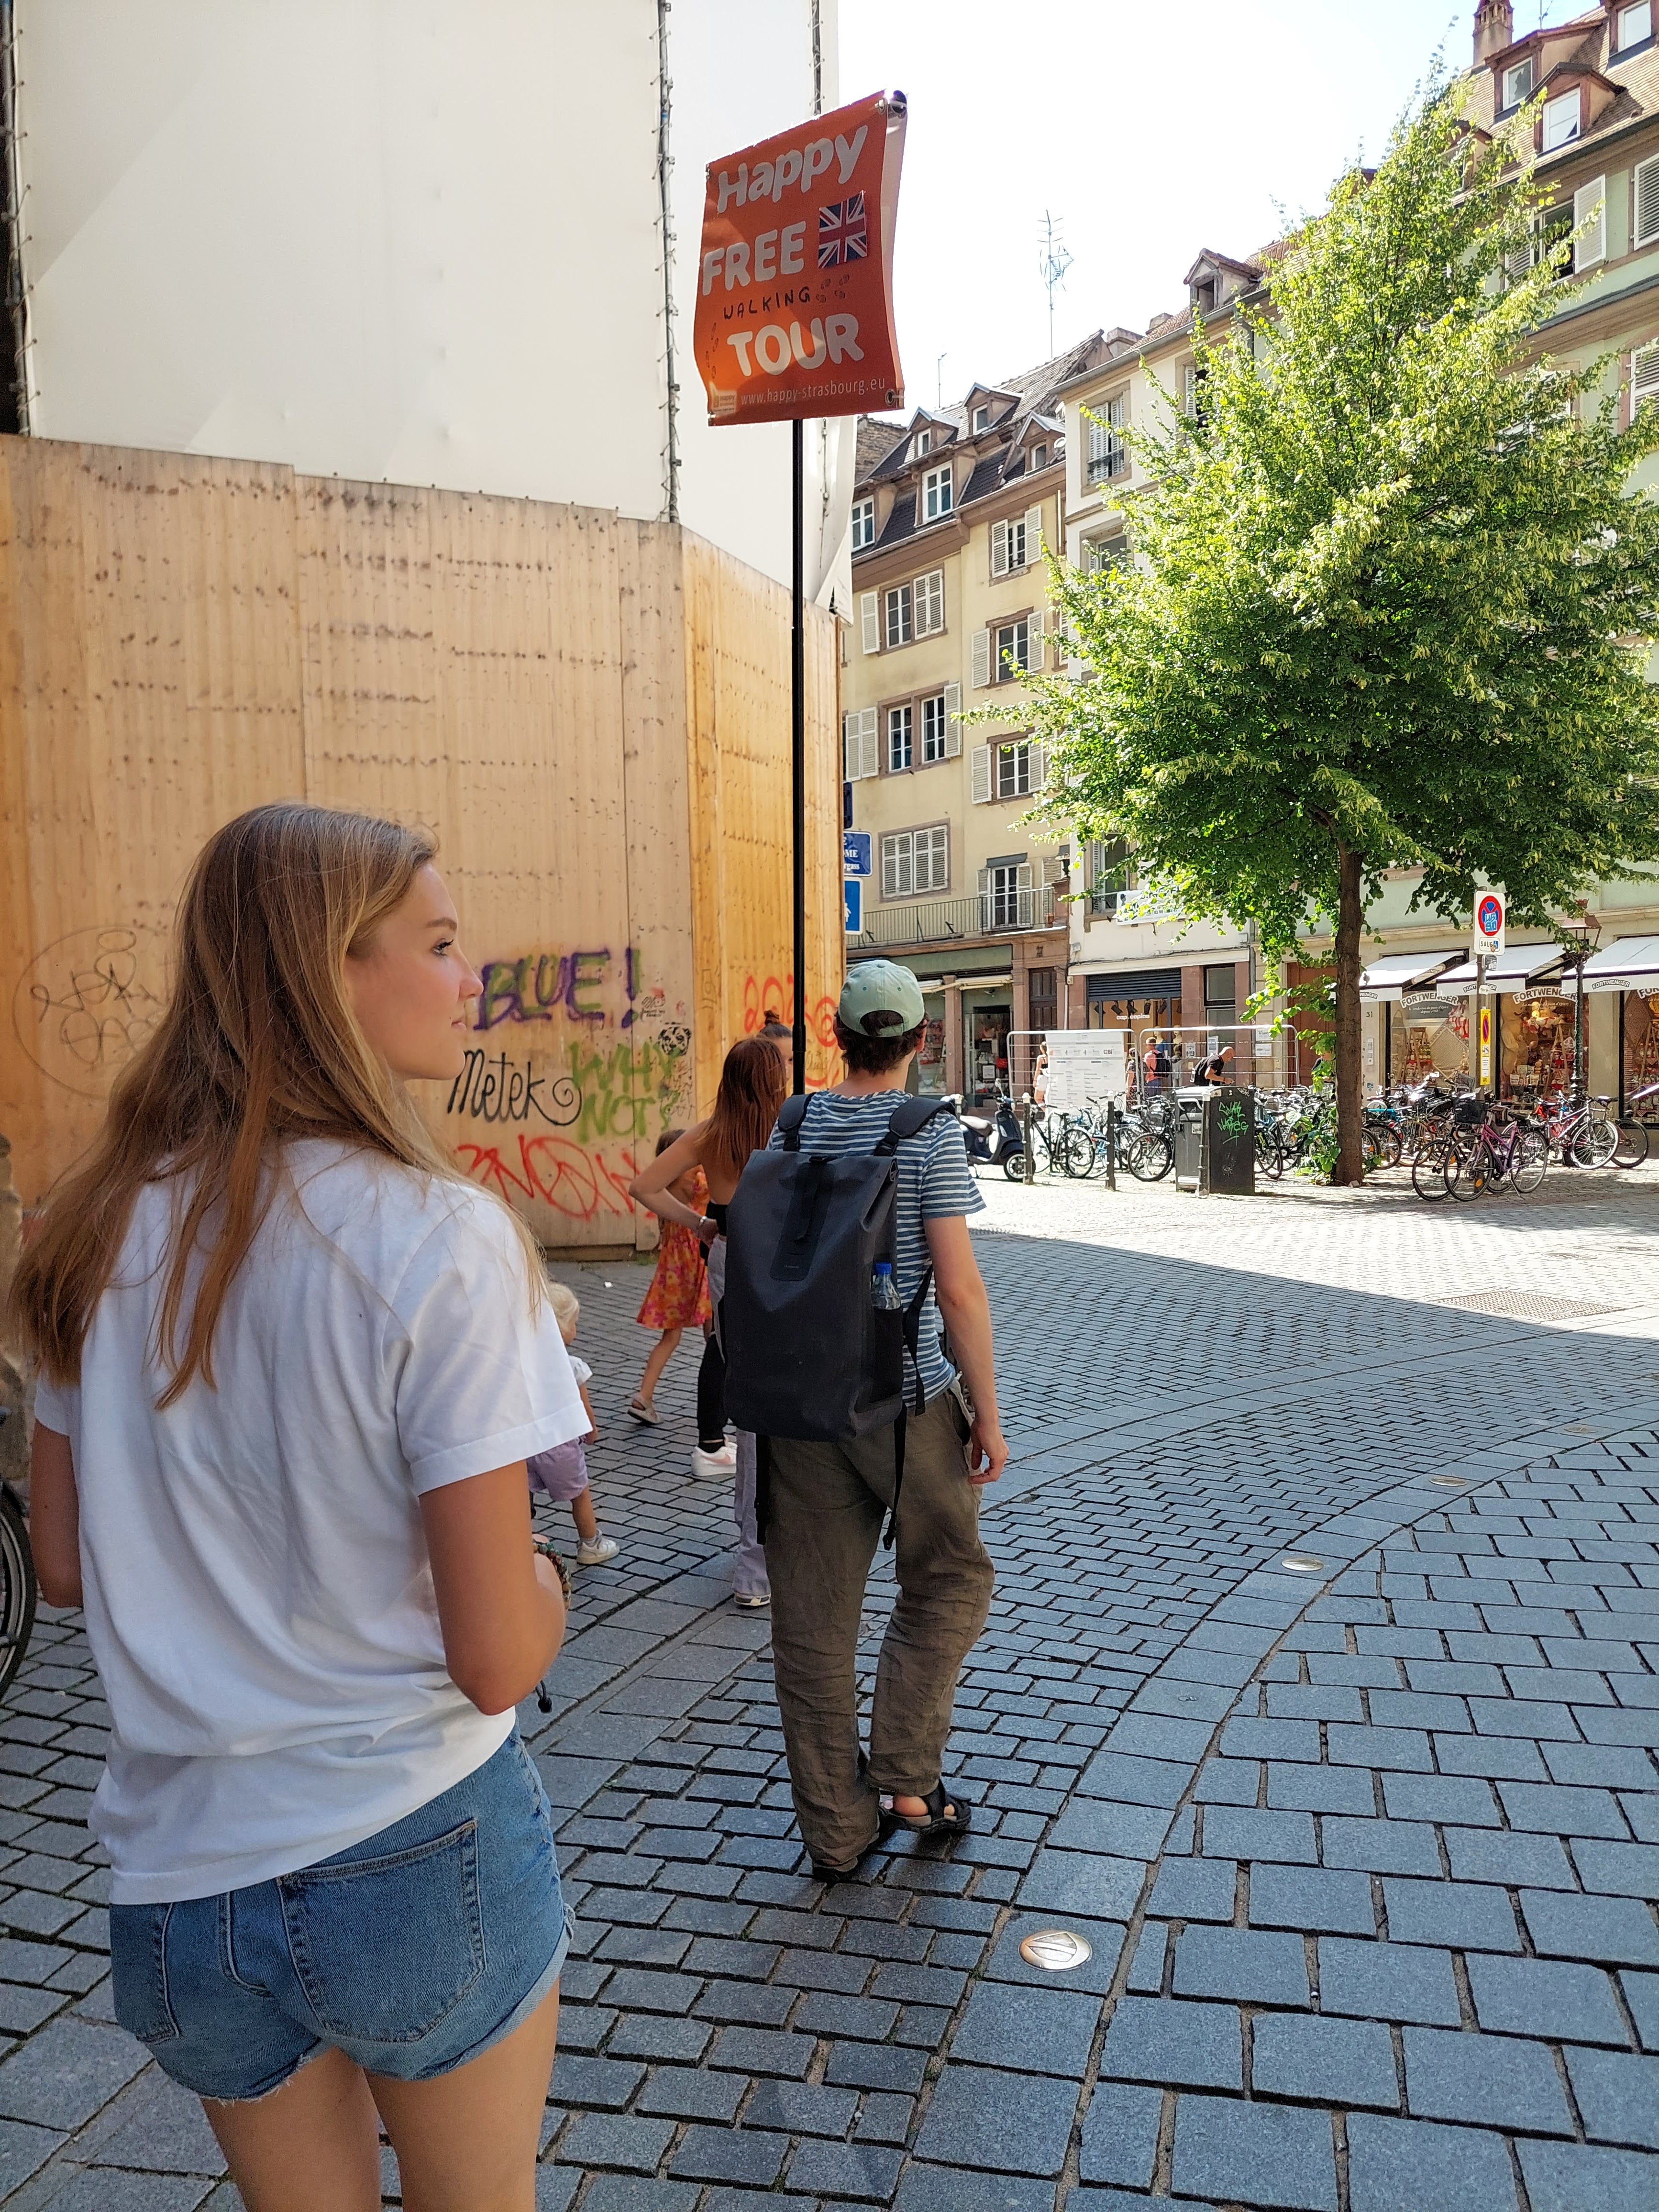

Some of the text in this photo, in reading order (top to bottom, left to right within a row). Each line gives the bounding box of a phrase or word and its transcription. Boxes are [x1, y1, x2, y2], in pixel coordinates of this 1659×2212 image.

[718, 124, 868, 214] Happy
[702, 221, 807, 296] FREE
[723, 286, 811, 320] WALKING
[727, 312, 865, 377] TOUR
[741, 377, 885, 406] www.happy-strasbourg.eu
[843, 849, 859, 858] ME
[1592, 979, 1630, 990] FORTWENGER
[569, 1040, 681, 1093] WHY
[577, 1090, 657, 1145] NOT
